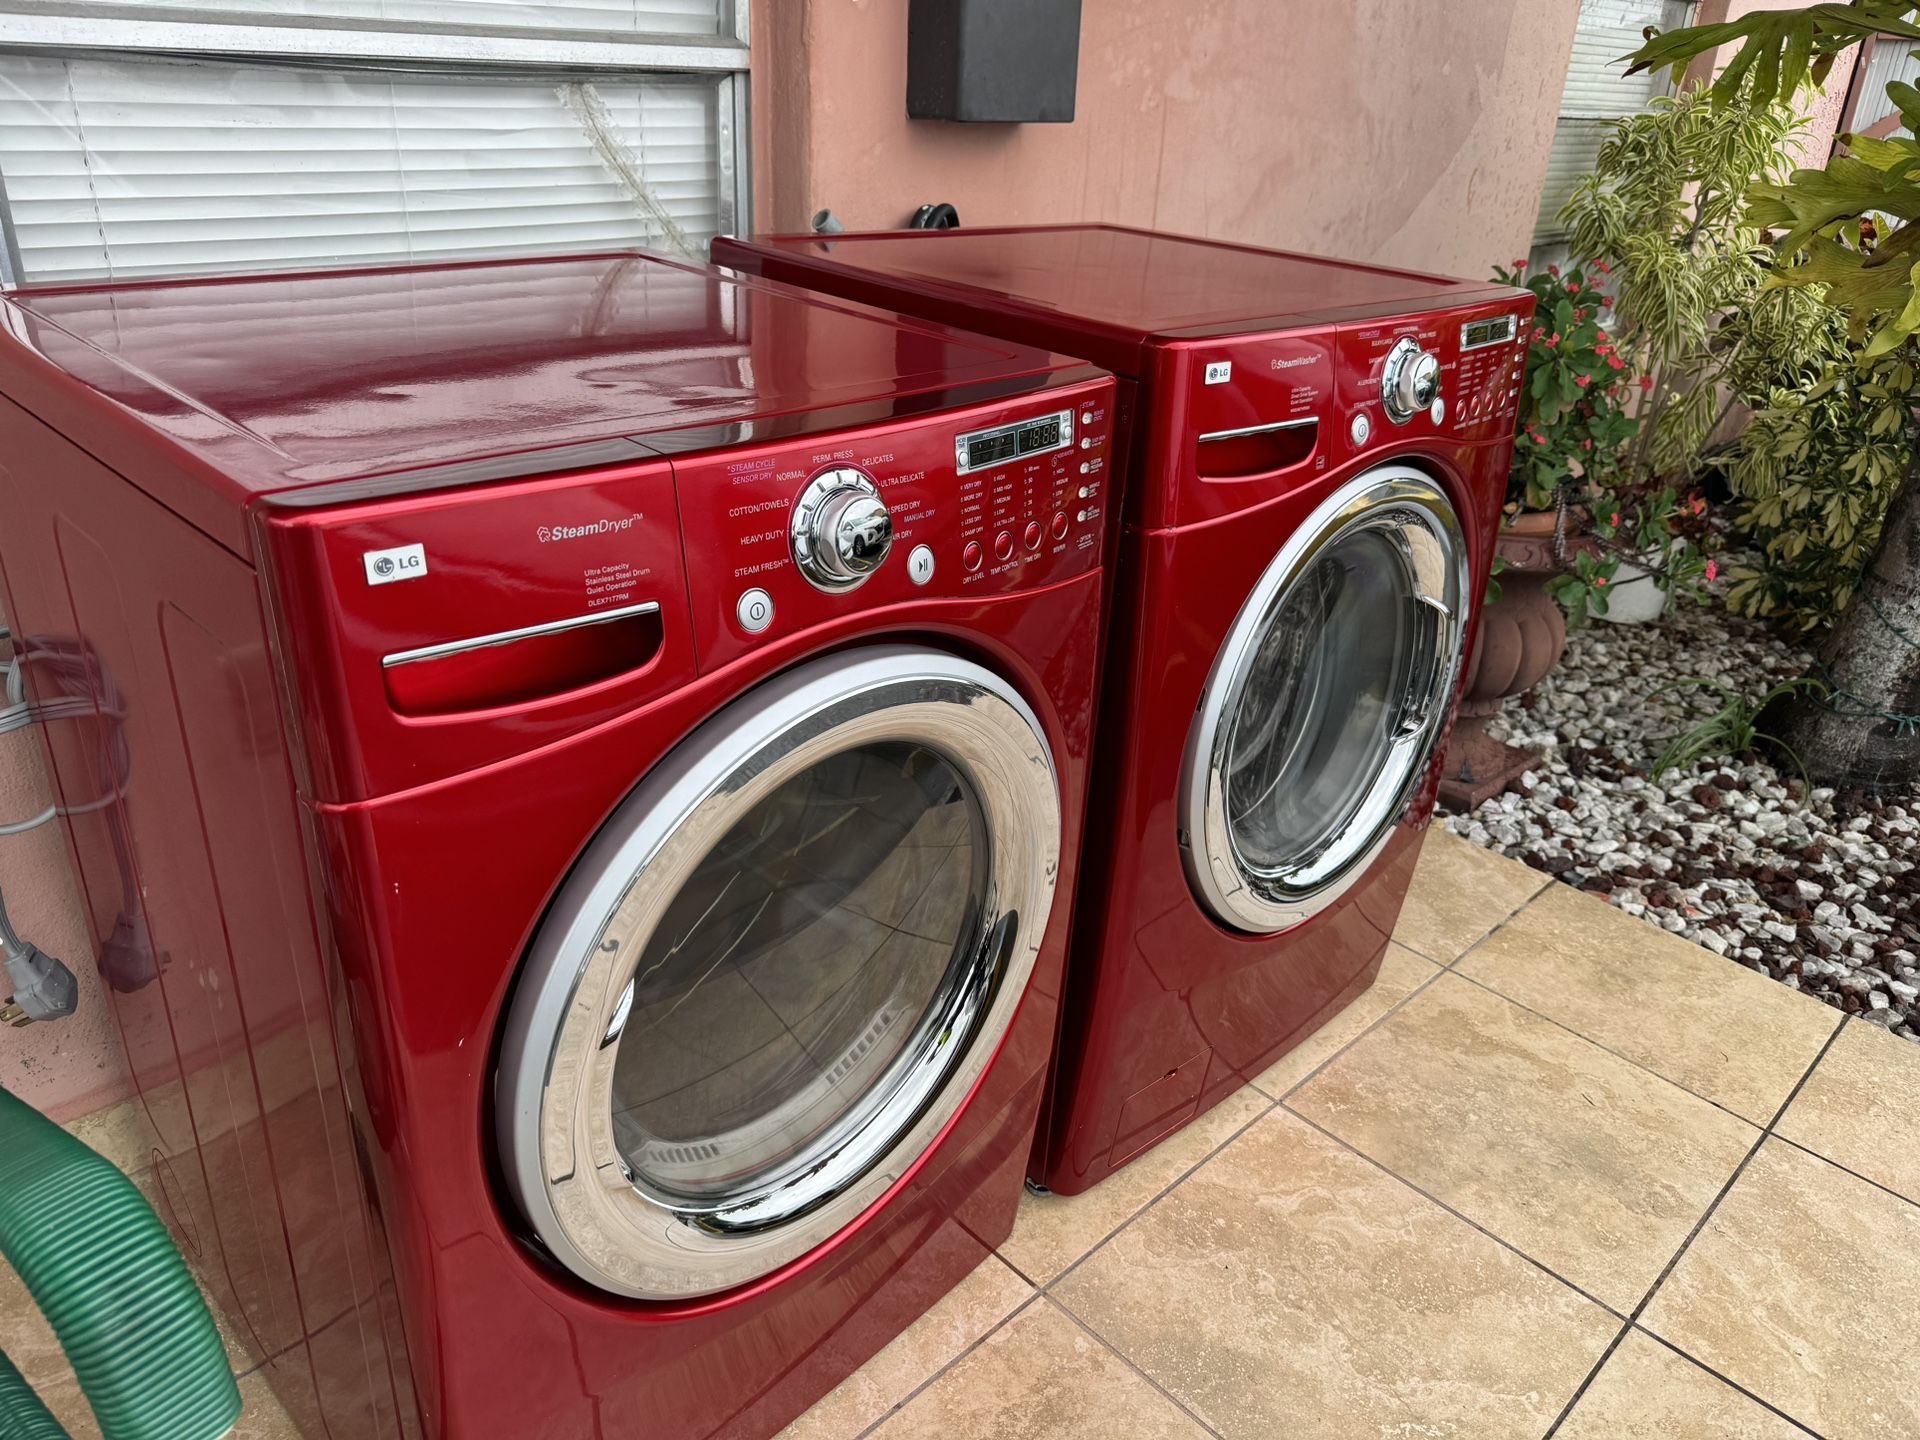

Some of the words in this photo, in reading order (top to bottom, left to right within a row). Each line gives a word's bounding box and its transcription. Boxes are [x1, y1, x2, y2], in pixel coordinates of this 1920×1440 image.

[1219, 368, 1228, 377] LG
[755, 458, 776, 469] CYCLE
[812, 453, 833, 464] PERM.
[834, 450, 854, 462] PRESS
[862, 454, 894, 467] DELICATES
[732, 474, 759, 485] SENSOR
[759, 472, 772, 481] DRY
[776, 469, 807, 482] NORMAL
[880, 477, 899, 488] ULTRA
[899, 472, 925, 484] DELICATE
[729, 498, 790, 518] COTTON/TOWELS
[891, 503, 909, 514] SPEED
[909, 500, 921, 509] DRY
[963, 504, 980, 514] NORMAL
[904, 514, 925, 523] MANUAL
[925, 509, 936, 518] DRY
[740, 533, 764, 545] HEAVY
[765, 529, 784, 541] DUTY
[901, 529, 913, 539] DRY
[399, 555, 420, 570] LG
[1002, 561, 1020, 572] CONTROL
[584, 568, 601, 577] Ultra
[602, 563, 630, 574] Capacity
[585, 575, 615, 586] Stainless
[615, 571, 632, 581] Steel
[633, 567, 650, 577] Drum
[734, 564, 760, 577] STEAM
[962, 575, 972, 585] DRY
[972, 571, 985, 582] LEVEL
[586, 586, 605, 595] Quiet
[605, 580, 637, 592] Operation
